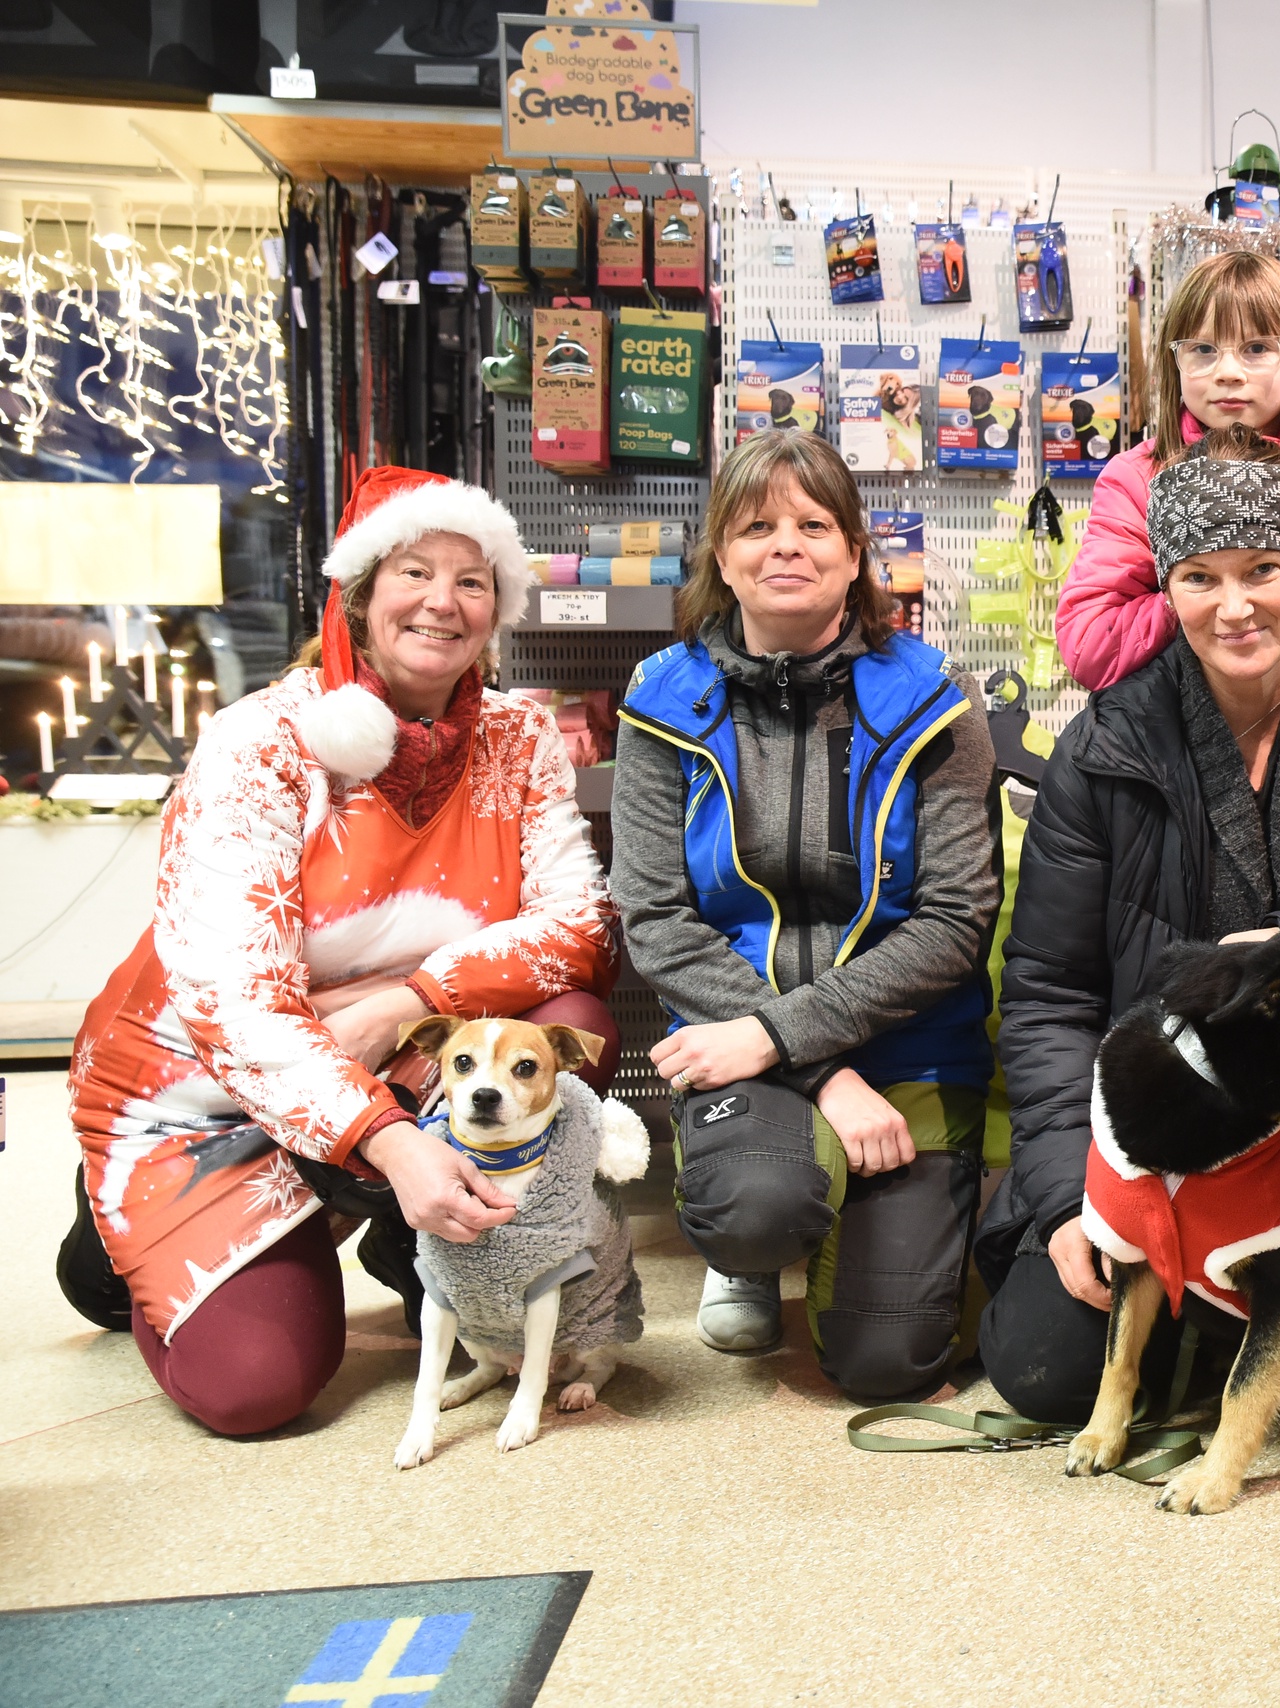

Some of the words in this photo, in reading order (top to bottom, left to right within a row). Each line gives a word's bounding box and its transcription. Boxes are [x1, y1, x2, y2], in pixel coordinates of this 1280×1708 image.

[546, 52, 653, 70] Biodegradable
[566, 71, 595, 84] dog
[599, 71, 634, 86] bags
[519, 87, 607, 120] Green
[615, 90, 690, 123] Bone
[621, 337, 692, 357] earth
[904, 348, 911, 358] S
[621, 357, 692, 378] rated
[537, 378, 568, 389] Green
[570, 378, 596, 389] Bone
[744, 375, 772, 385] TRIXIE
[944, 373, 973, 383] TRIXIE
[1046, 387, 1074, 397] TRIXIE
[843, 397, 878, 411] Safety
[843, 407, 868, 418] Vest
[619, 427, 646, 440] Poop
[647, 429, 673, 441] Bags
[619, 440, 637, 450] 120
[558, 613, 577, 621] 39:-
